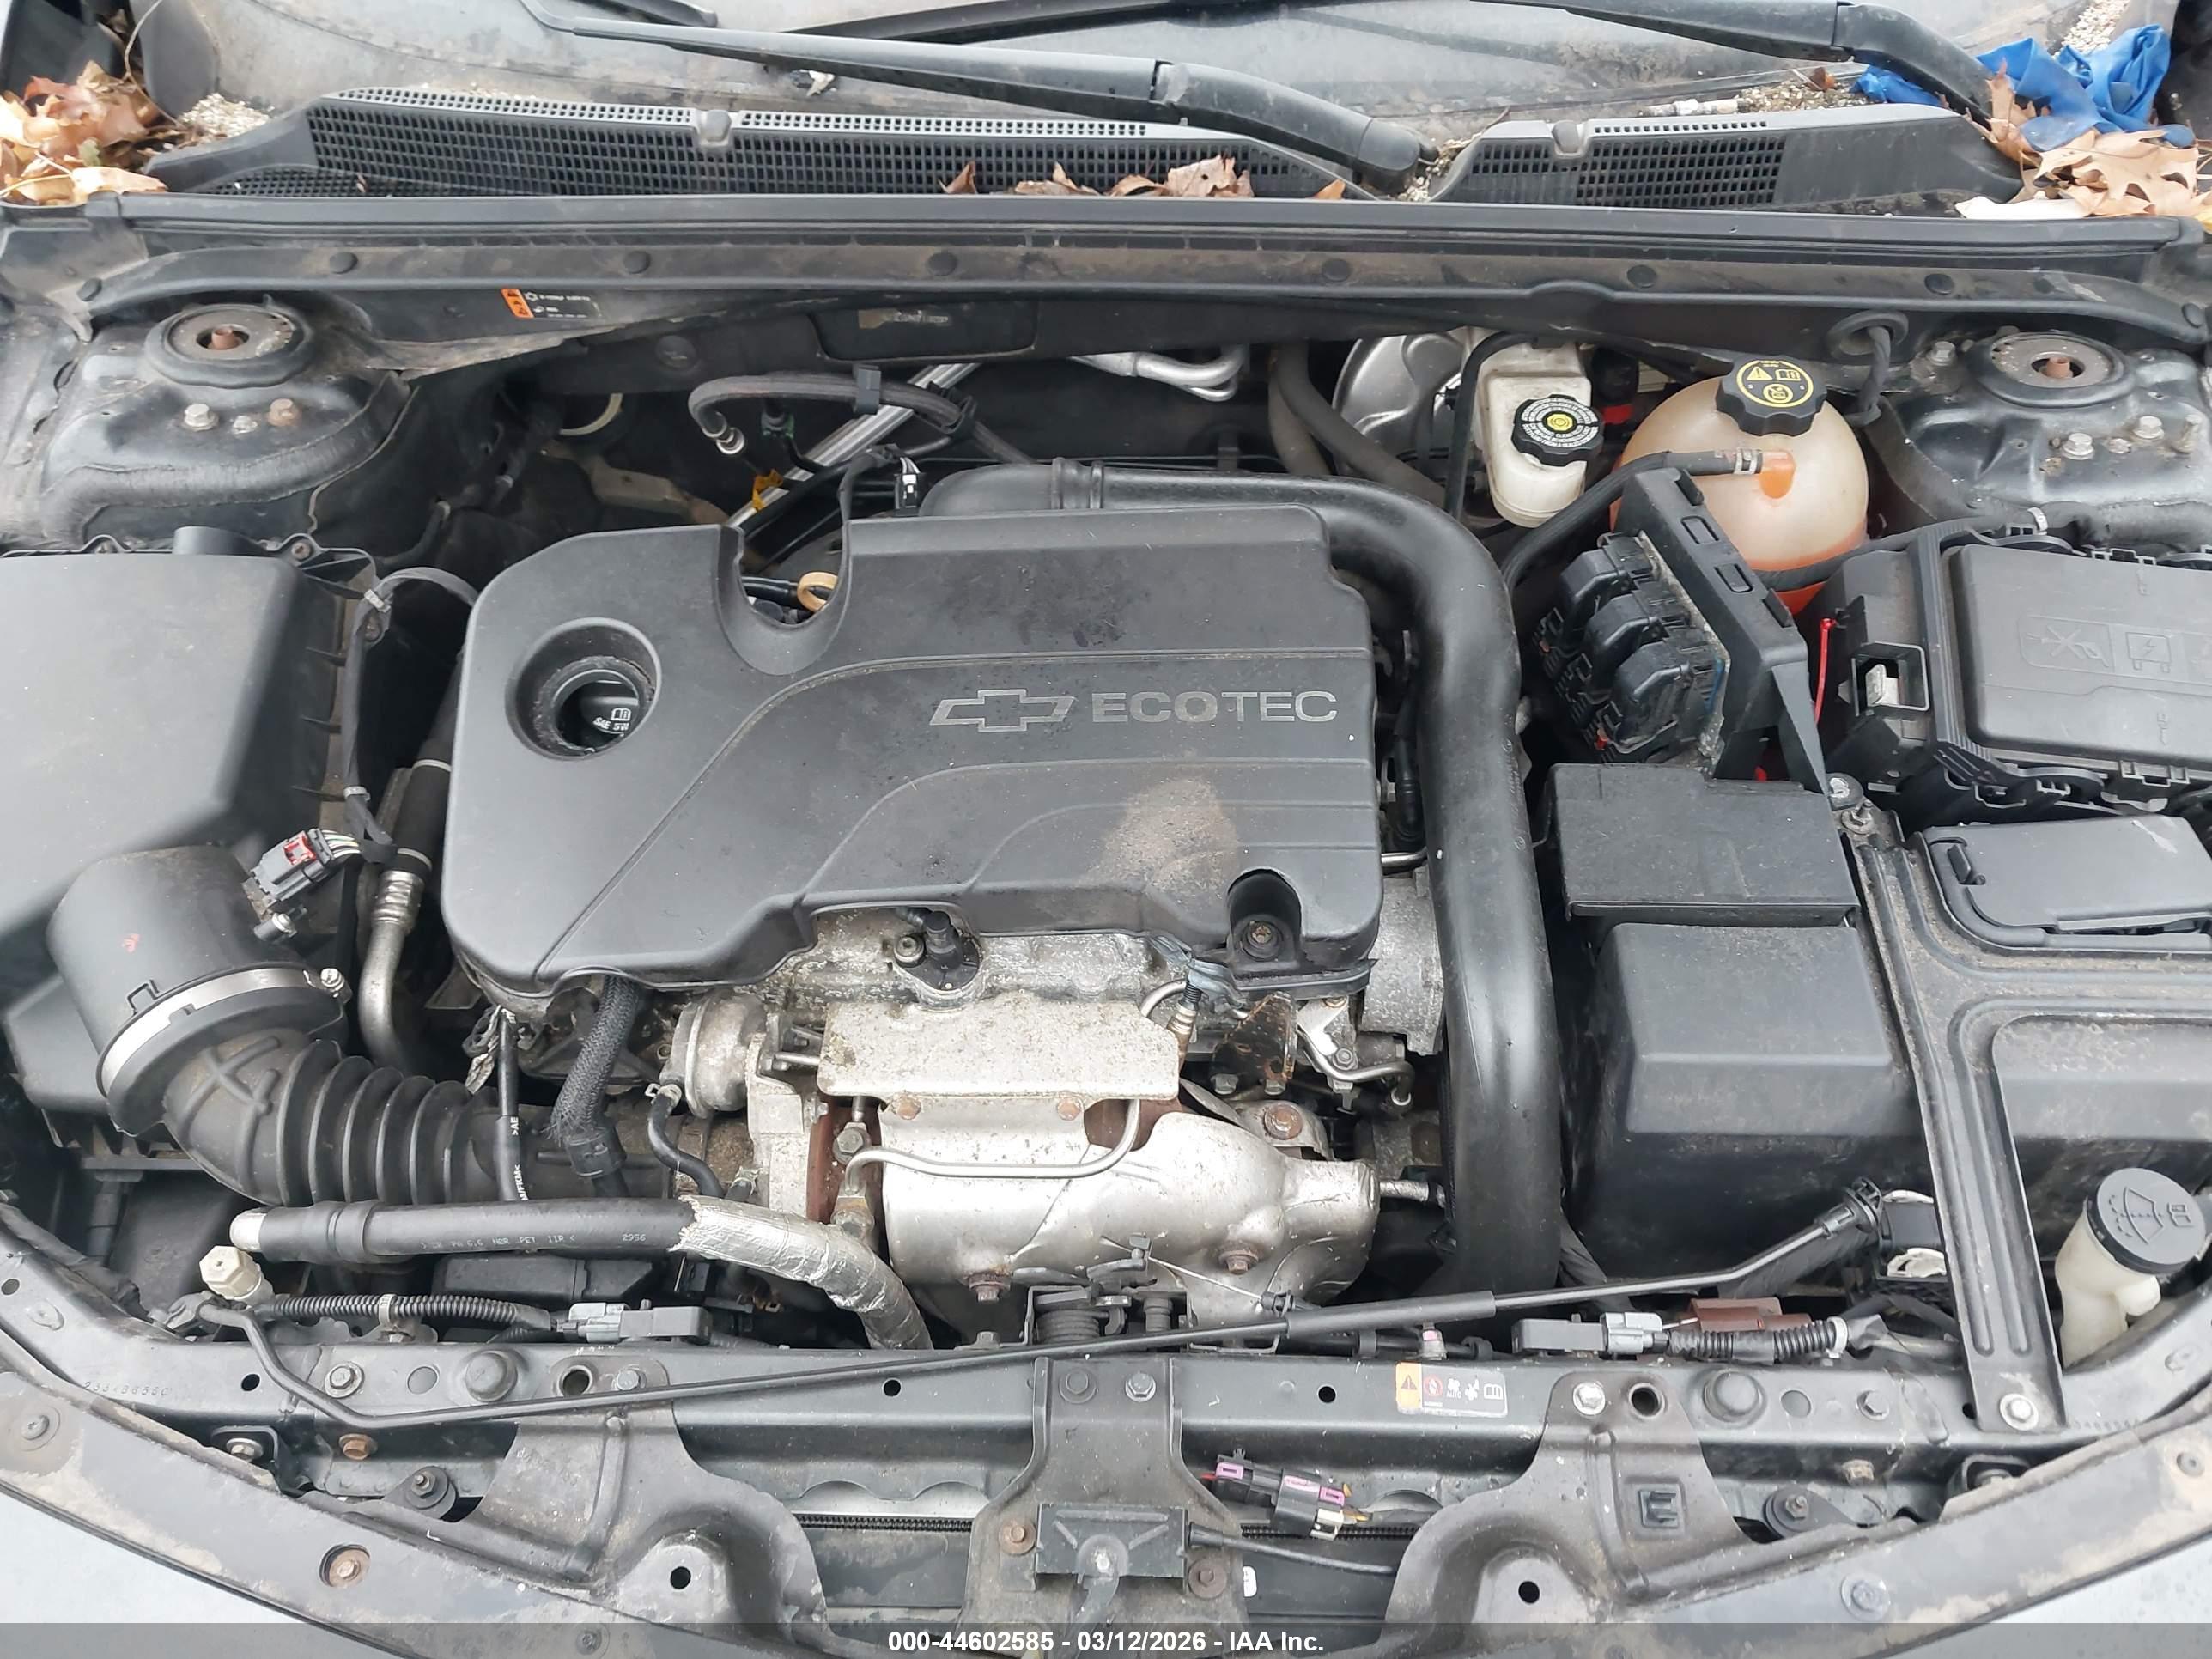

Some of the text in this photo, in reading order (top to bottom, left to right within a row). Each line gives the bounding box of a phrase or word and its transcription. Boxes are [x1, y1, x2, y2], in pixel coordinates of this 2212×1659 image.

[1091, 690, 1339, 723] ECOTEC
[592, 717, 611, 730] SAE
[622, 1233, 647, 1242] 2956
